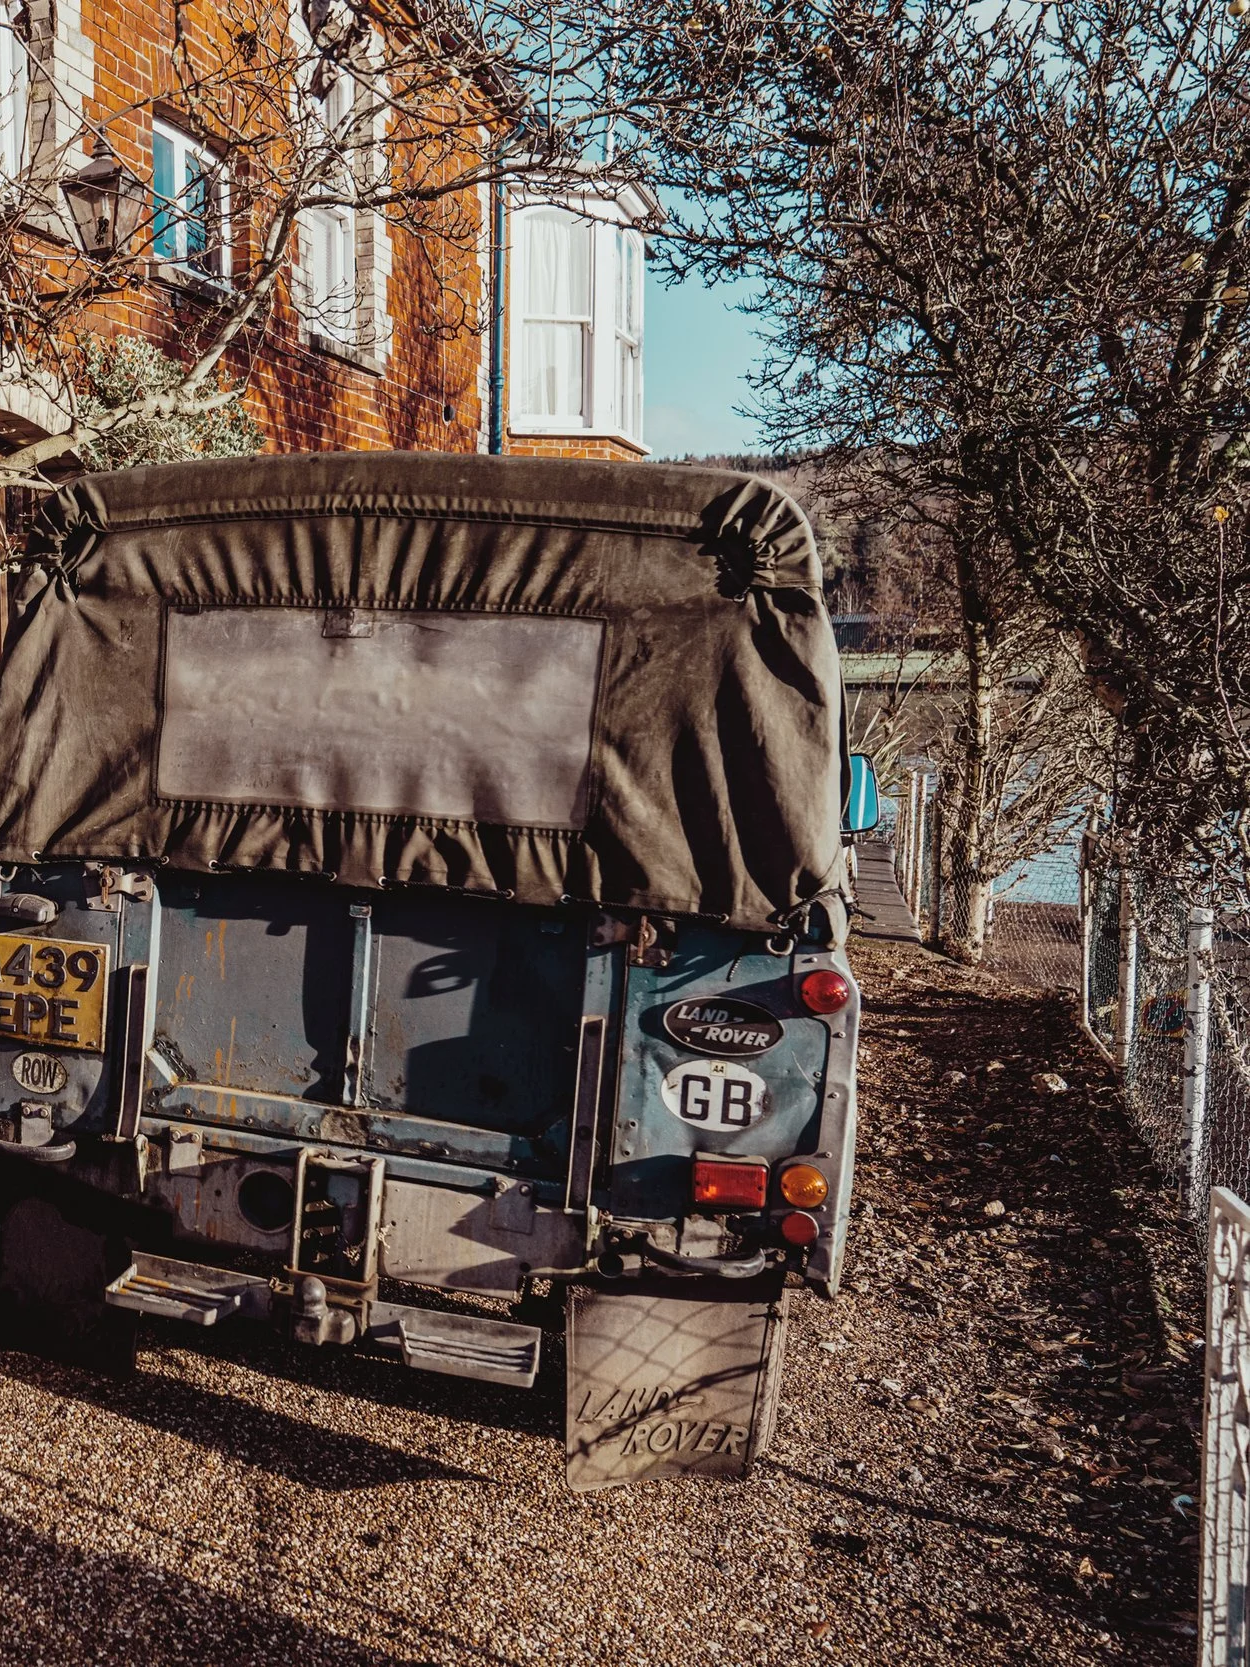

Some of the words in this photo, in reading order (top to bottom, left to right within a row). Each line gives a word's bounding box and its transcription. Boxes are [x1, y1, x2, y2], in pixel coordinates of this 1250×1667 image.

[677, 1005, 728, 1024] LAND
[705, 1026, 770, 1048] ROVER
[21, 1056, 58, 1088] ROW
[679, 1074, 752, 1127] GB
[575, 1386, 674, 1423] LAND
[620, 1422, 749, 1456] ROVER
